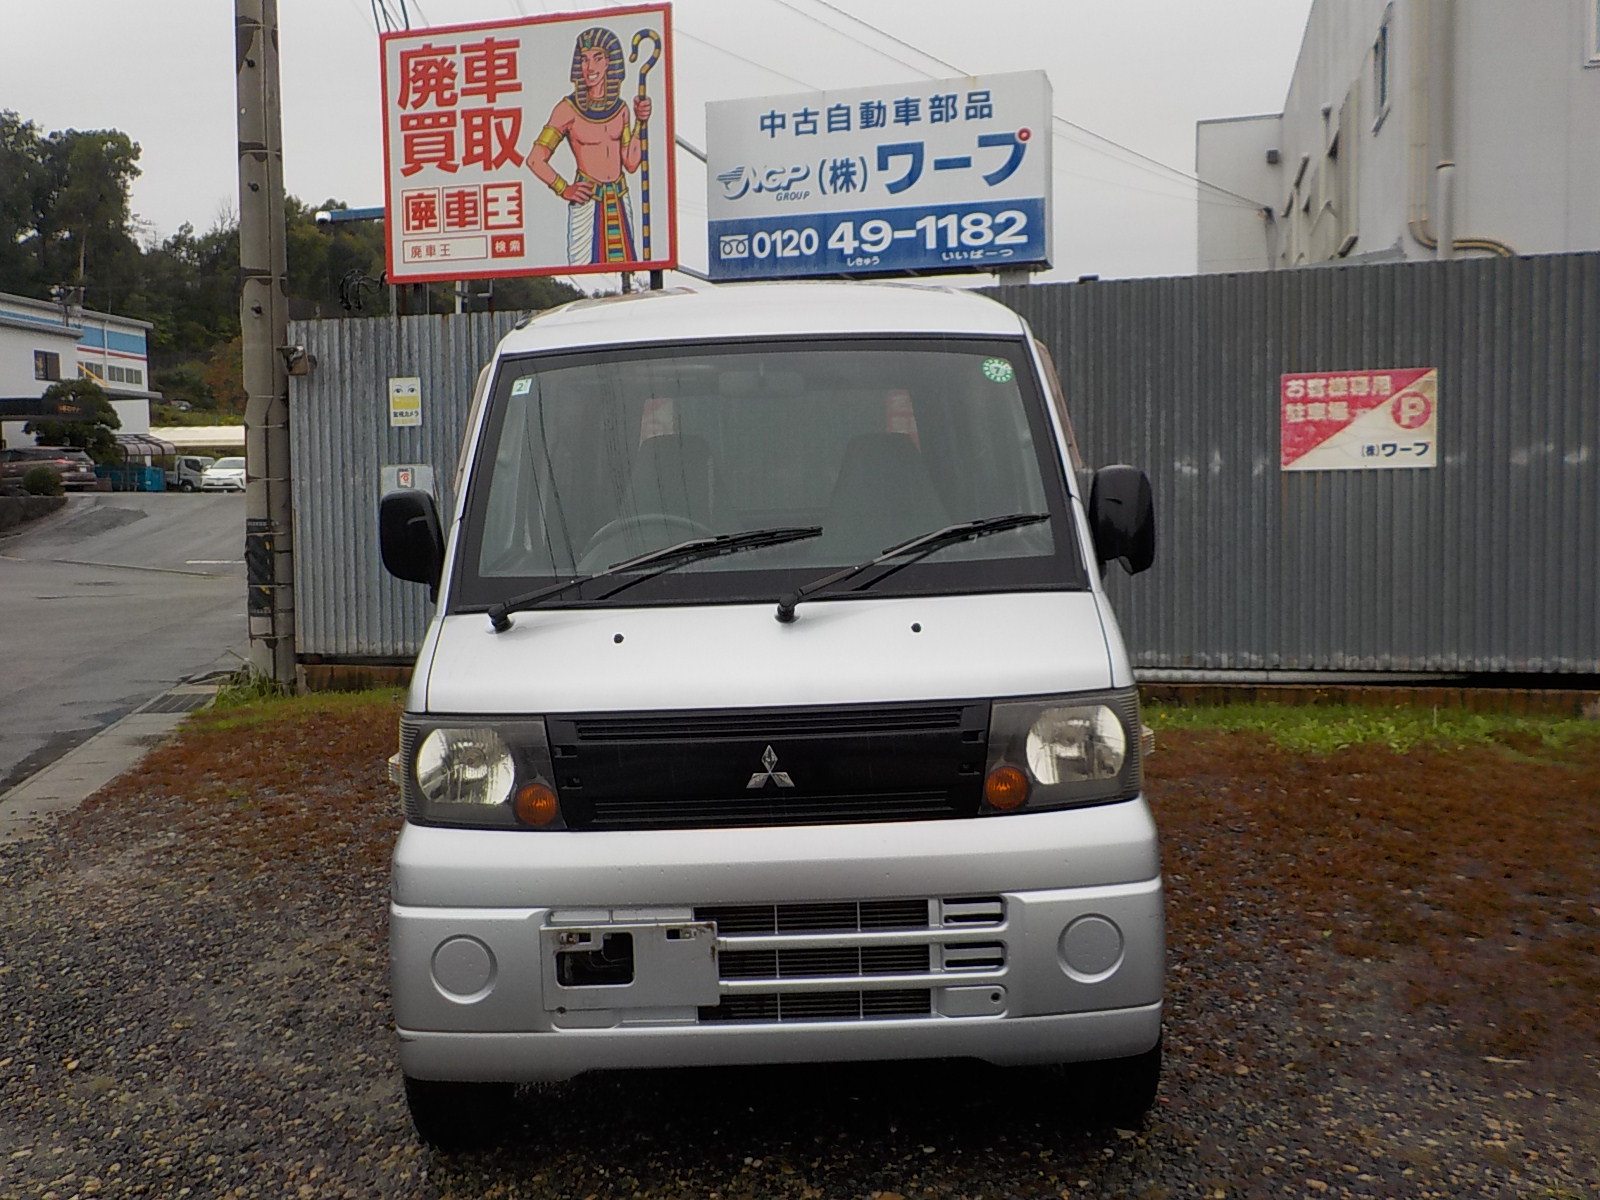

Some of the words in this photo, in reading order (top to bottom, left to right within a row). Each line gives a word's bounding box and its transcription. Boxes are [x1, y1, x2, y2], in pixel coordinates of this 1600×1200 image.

[397, 37, 522, 110] 廃車
[759, 90, 993, 139] 中古自動車部品
[400, 107, 524, 177] 買取
[818, 127, 1032, 196] (株)ワープ
[402, 182, 523, 235] 廃車王
[775, 190, 810, 202] GROUP
[410, 244, 451, 258] 廃車王
[752, 227, 819, 259] 0120
[827, 209, 1028, 255] 49-1182
[847, 257, 880, 267] しきゅう
[516, 382, 524, 391] 2
[993, 366, 1001, 374] 7
[1401, 397, 1424, 425] P
